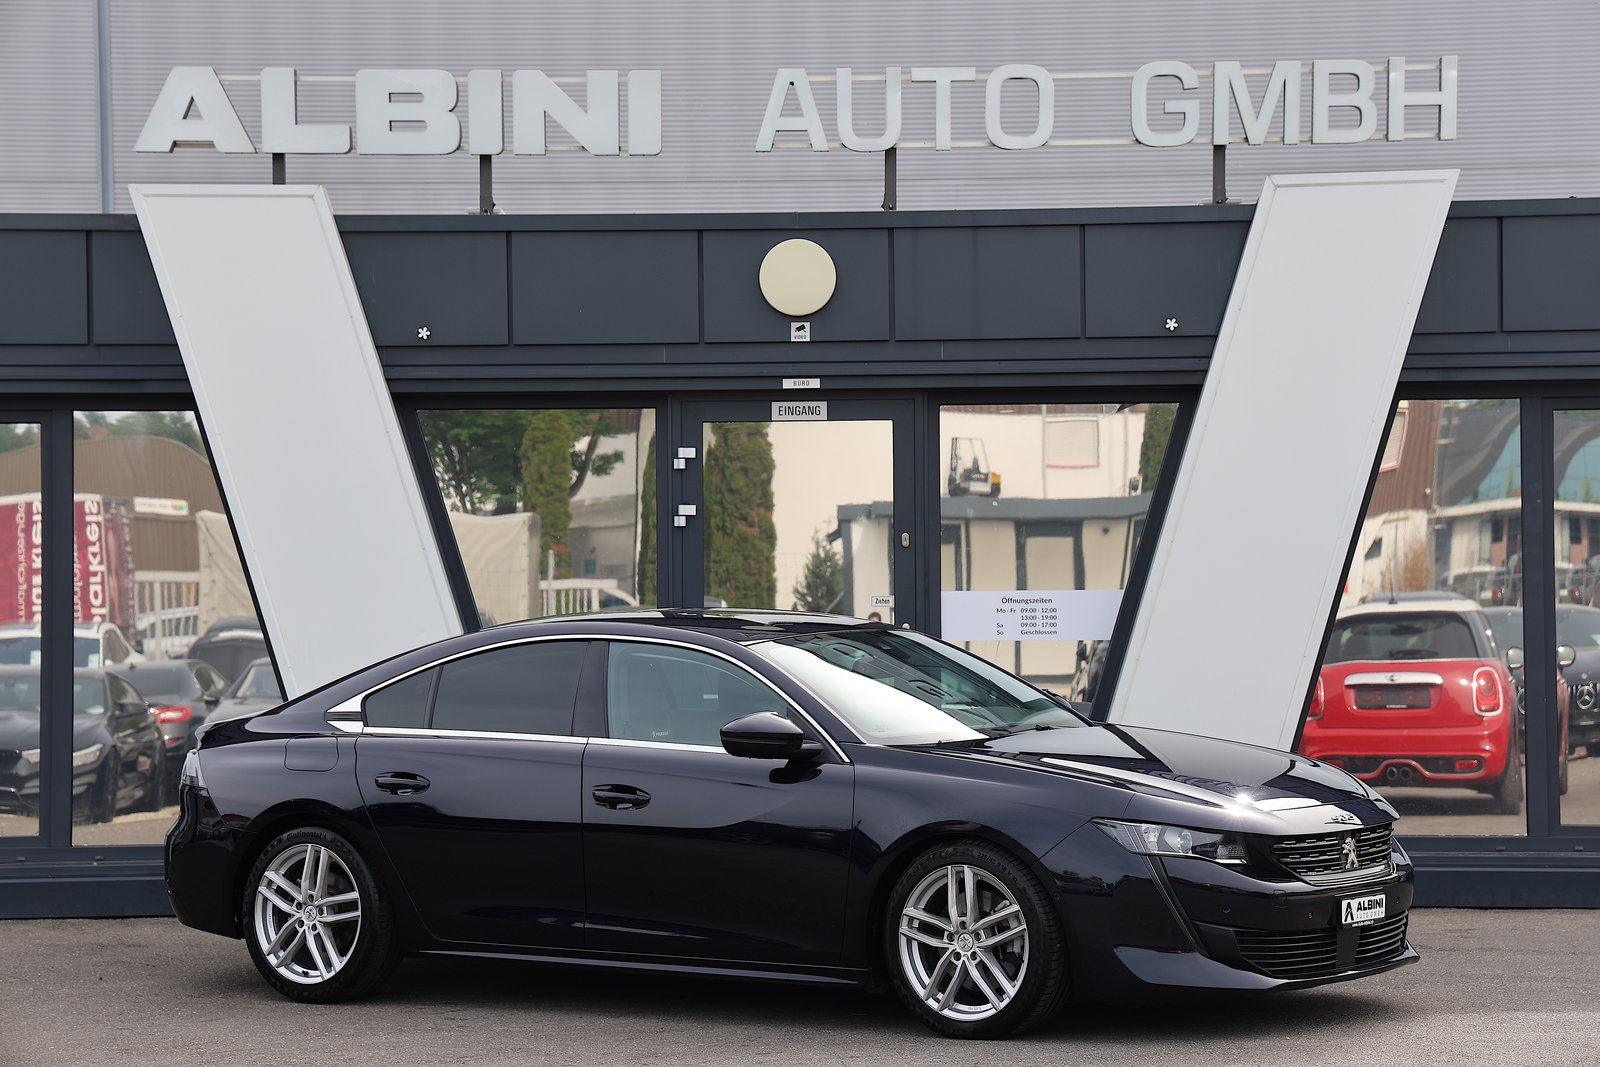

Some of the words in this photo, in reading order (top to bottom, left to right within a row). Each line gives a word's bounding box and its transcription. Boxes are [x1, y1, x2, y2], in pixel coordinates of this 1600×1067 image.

[134, 66, 662, 156] ALBINI
[755, 64, 1056, 152] AUTO
[1130, 55, 1458, 148] GMBH
[778, 405, 821, 416] EINGANG
[1001, 597, 1053, 605] Öffnungszeiten
[286, 830, 323, 841] Continental
[1356, 897, 1384, 912] ALBINI
